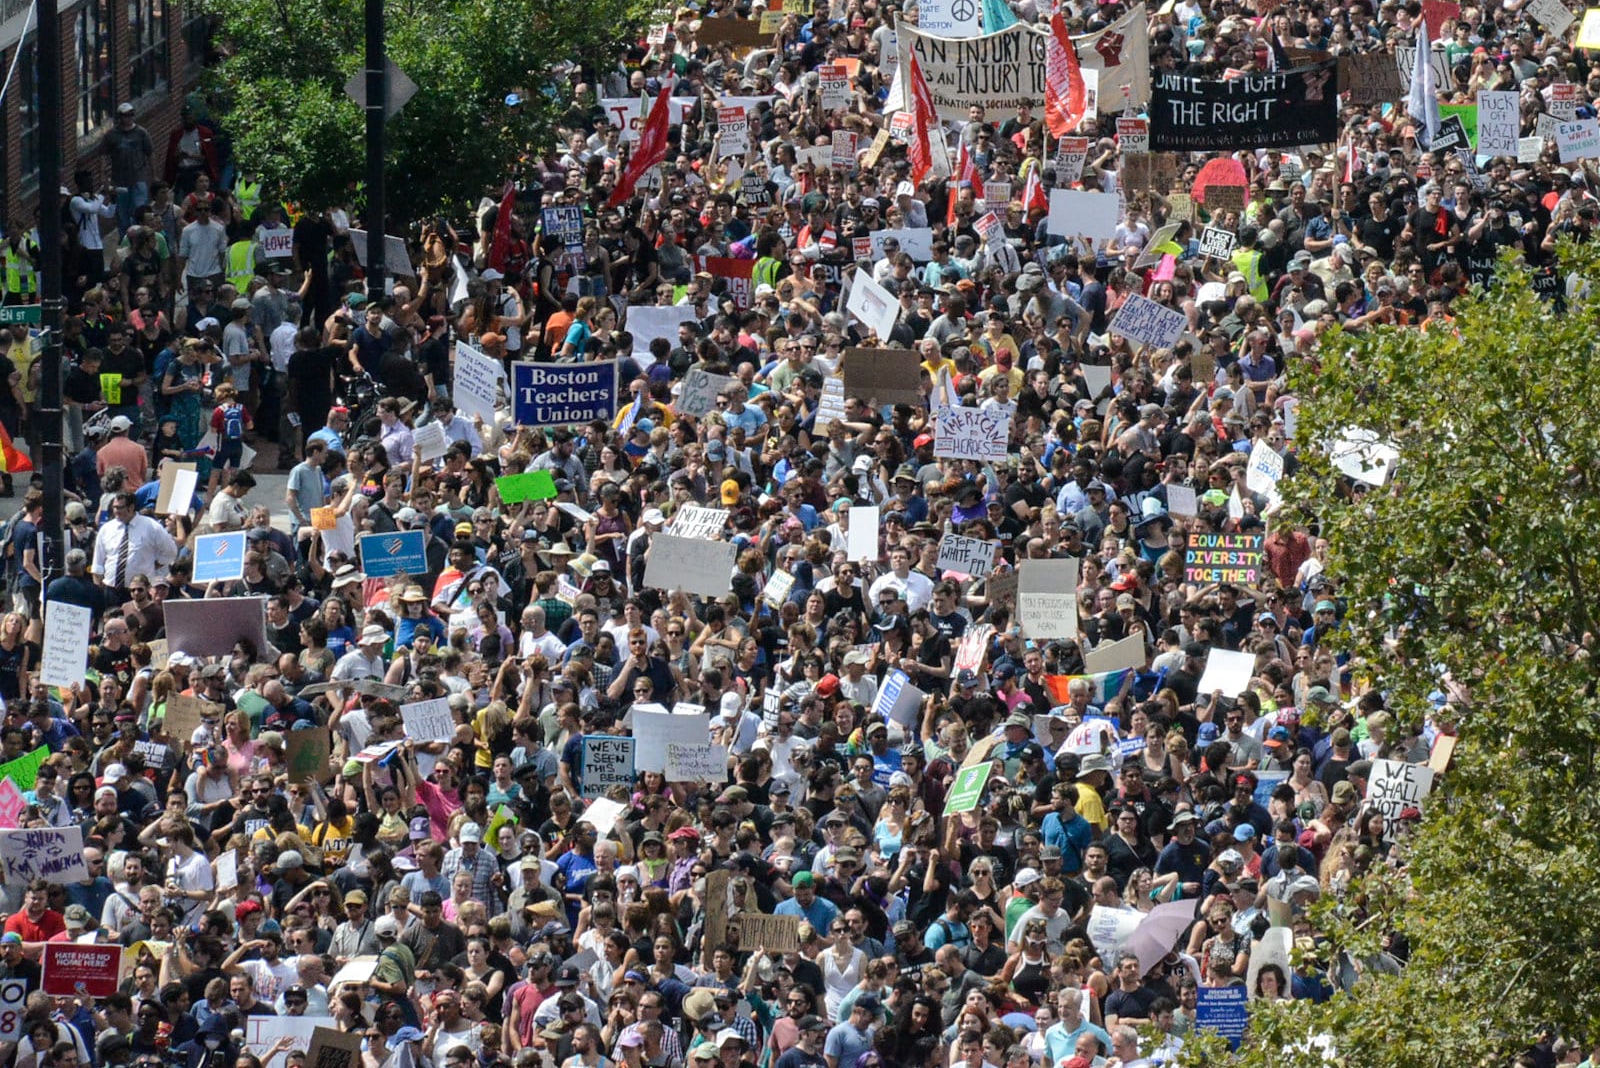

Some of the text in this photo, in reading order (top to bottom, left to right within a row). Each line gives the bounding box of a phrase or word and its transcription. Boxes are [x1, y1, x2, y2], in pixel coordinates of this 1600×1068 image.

[920, 22, 953, 30] BOSTON
[915, 30, 1046, 64] AN INJURY TO
[937, 70, 955, 85] AN
[956, 63, 1021, 94] INJURY
[1397, 48, 1450, 93] REST
[820, 81, 847, 91] STOP
[1155, 74, 1287, 94] UNITE FIGHT
[985, 98, 1020, 110] SOCIALIS
[1481, 94, 1514, 112] FUCK
[1168, 97, 1278, 127] THE RIGHT
[719, 122, 745, 133] STOP
[1481, 123, 1515, 140] NAZI
[1560, 124, 1582, 135] END
[1120, 135, 1146, 146] STOP
[1481, 138, 1517, 152] SCUM
[1059, 153, 1083, 164] STOP
[265, 235, 291, 252] LOVE
[1205, 231, 1232, 242] BLACK
[1205, 238, 1229, 249] LIVES
[1201, 244, 1229, 257] MATTER
[16, 312, 26, 321] ST
[532, 369, 599, 386] Boston
[690, 373, 709, 389] NO
[521, 387, 610, 405] Teachers
[537, 406, 594, 424] Union
[942, 412, 1005, 441] AMERICAN
[952, 439, 991, 456] HEROES
[680, 508, 728, 525] NO HATE
[670, 523, 688, 537] NO
[944, 535, 993, 558] STOP IT,
[1188, 534, 1262, 549] EQUALITY
[941, 546, 970, 564] WHITE
[1186, 550, 1263, 566] DIVERSITY
[1186, 567, 1256, 583] TOGETHER
[1036, 622, 1057, 630] AGAIN
[134, 741, 168, 754] BOSTON
[588, 741, 629, 753] WE'VE
[593, 753, 625, 765] SEEN
[586, 764, 616, 774] THIS
[1385, 761, 1417, 783] WE
[600, 773, 632, 783] BEFOR
[1374, 779, 1419, 804] SHALL
[1372, 800, 1398, 818] NOT
[55, 952, 112, 962] HATE HAS NO
